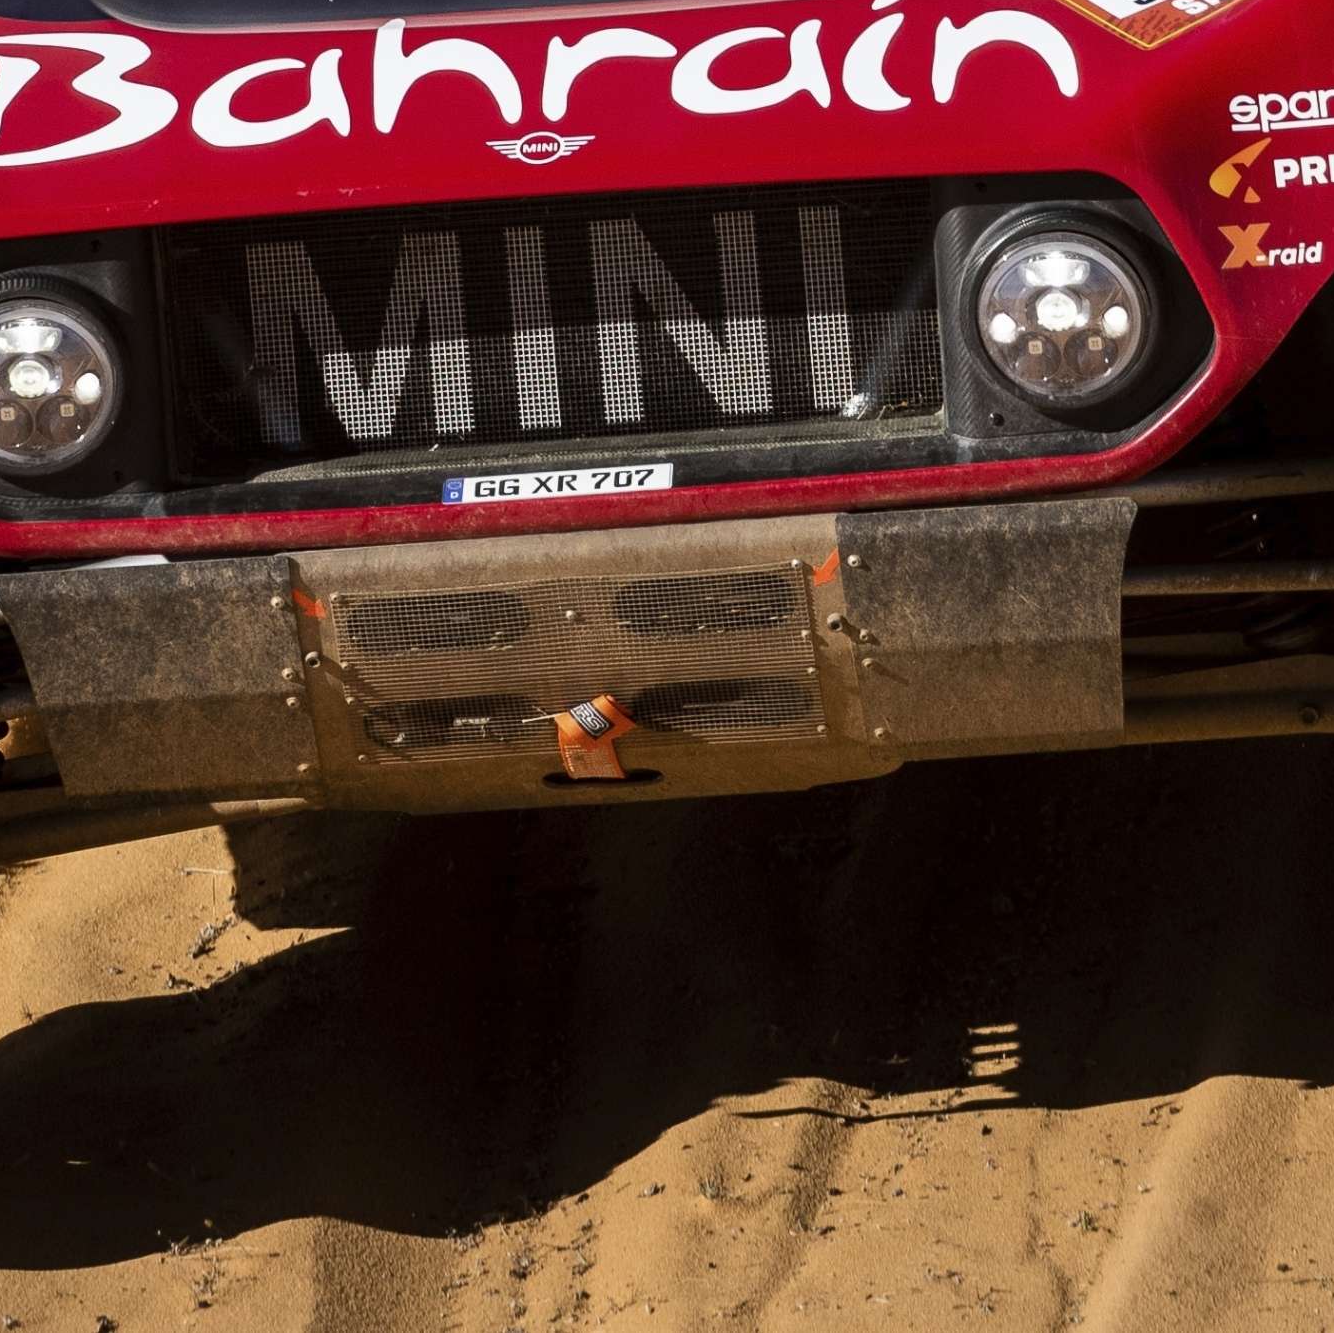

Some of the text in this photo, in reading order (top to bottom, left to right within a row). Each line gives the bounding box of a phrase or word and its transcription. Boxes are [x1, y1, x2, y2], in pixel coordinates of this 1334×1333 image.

[522, 142, 558, 153] MINI
[1218, 222, 1323, 269] X-raid
[245, 206, 854, 444] MINI
[474, 478, 520, 498] GG
[531, 474, 578, 494] XR
[591, 468, 655, 489] 707
